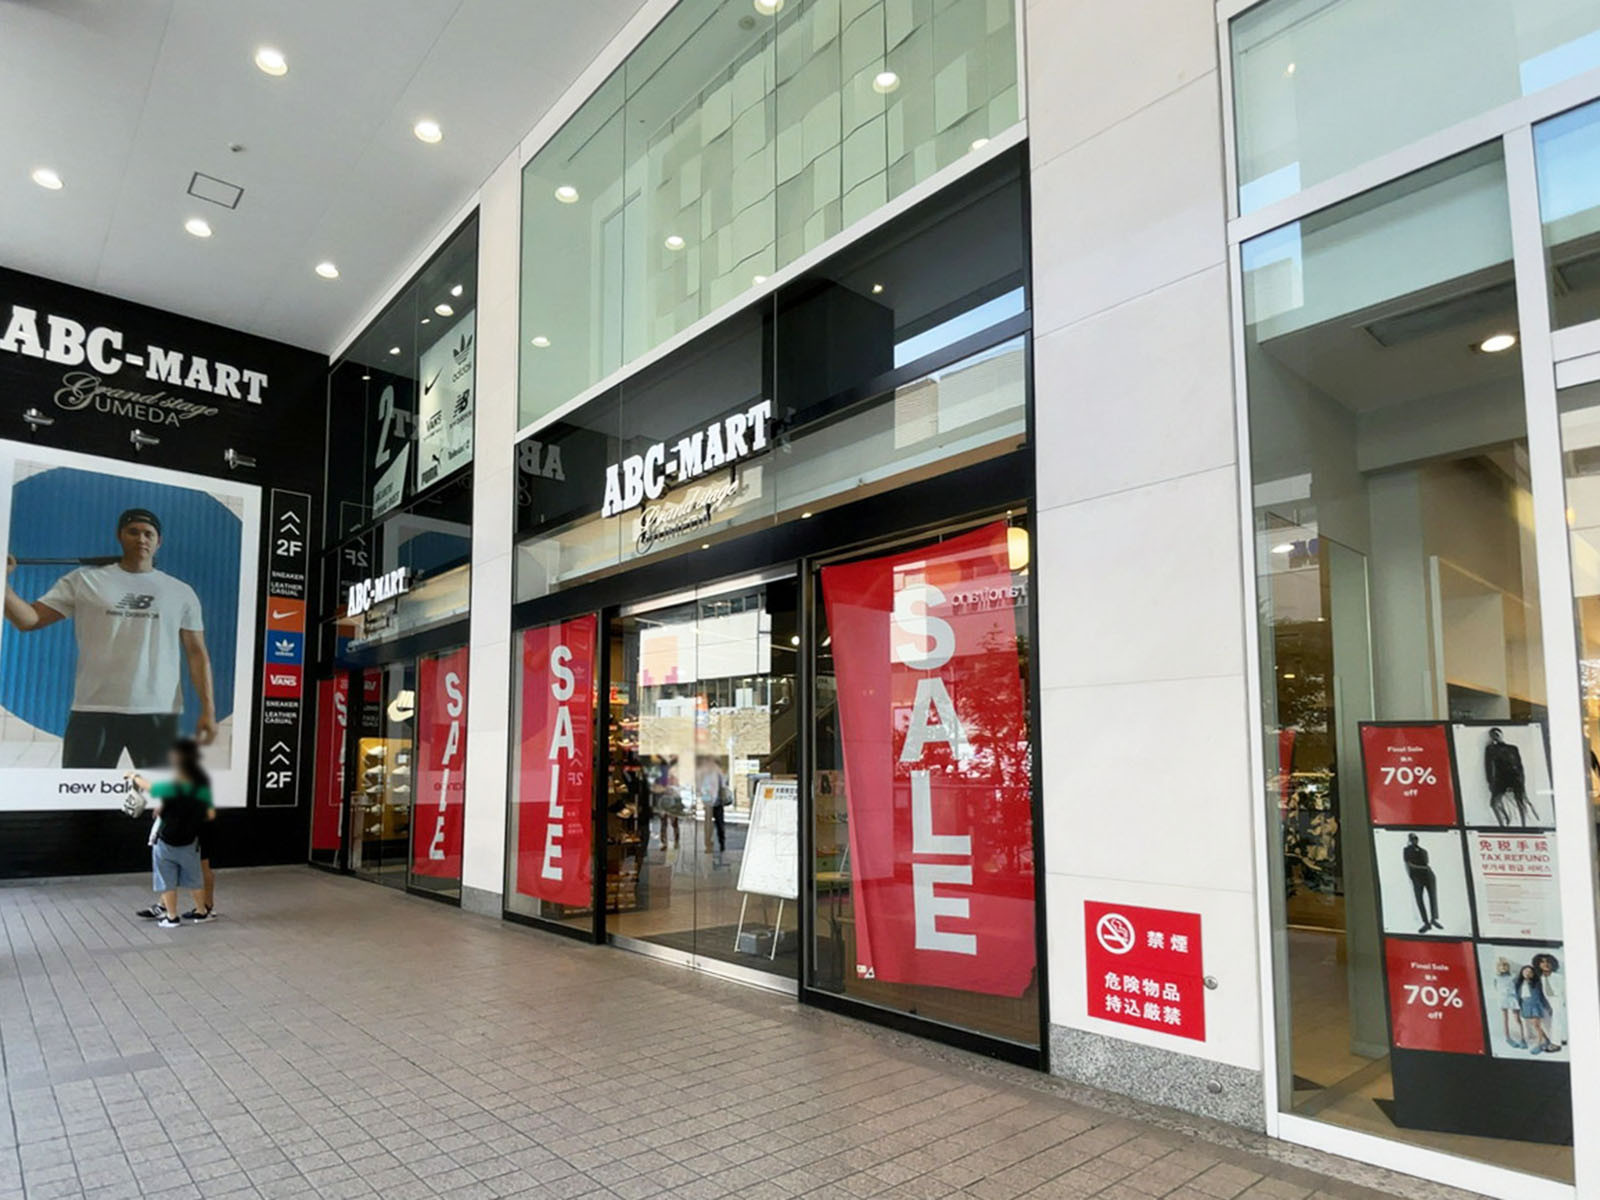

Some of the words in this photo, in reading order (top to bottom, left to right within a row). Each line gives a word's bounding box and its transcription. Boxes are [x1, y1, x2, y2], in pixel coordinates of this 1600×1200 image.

[0, 305, 268, 404] ABC-MART
[54, 371, 164, 410] Grand
[159, 392, 219, 420] stage
[94, 397, 181, 428] UMEDA
[601, 399, 771, 518] ABC-MART
[276, 539, 303, 557] 2F
[271, 570, 305, 580] SNEAKER
[271, 581, 304, 591] LEATHER
[347, 566, 408, 617] ABC-MART
[270, 674, 298, 687] VANS
[264, 711, 298, 719] LEATHER
[429, 672, 463, 860] SALE
[541, 645, 575, 881] SALE
[895, 583, 978, 955] SALE
[265, 771, 292, 788] 2F
[1380, 766, 1437, 785] 70%
[58, 781, 96, 794] new
[1403, 789, 1418, 797] off
[1480, 853, 1502, 861] TAX
[1504, 853, 1551, 863] REFUND
[1146, 930, 1189, 953] 禁煙
[1104, 971, 1181, 1003] 危険物品
[1403, 985, 1463, 1008] 70%
[1104, 993, 1182, 1026] 持込厳禁
[1427, 1011, 1443, 1020] off
